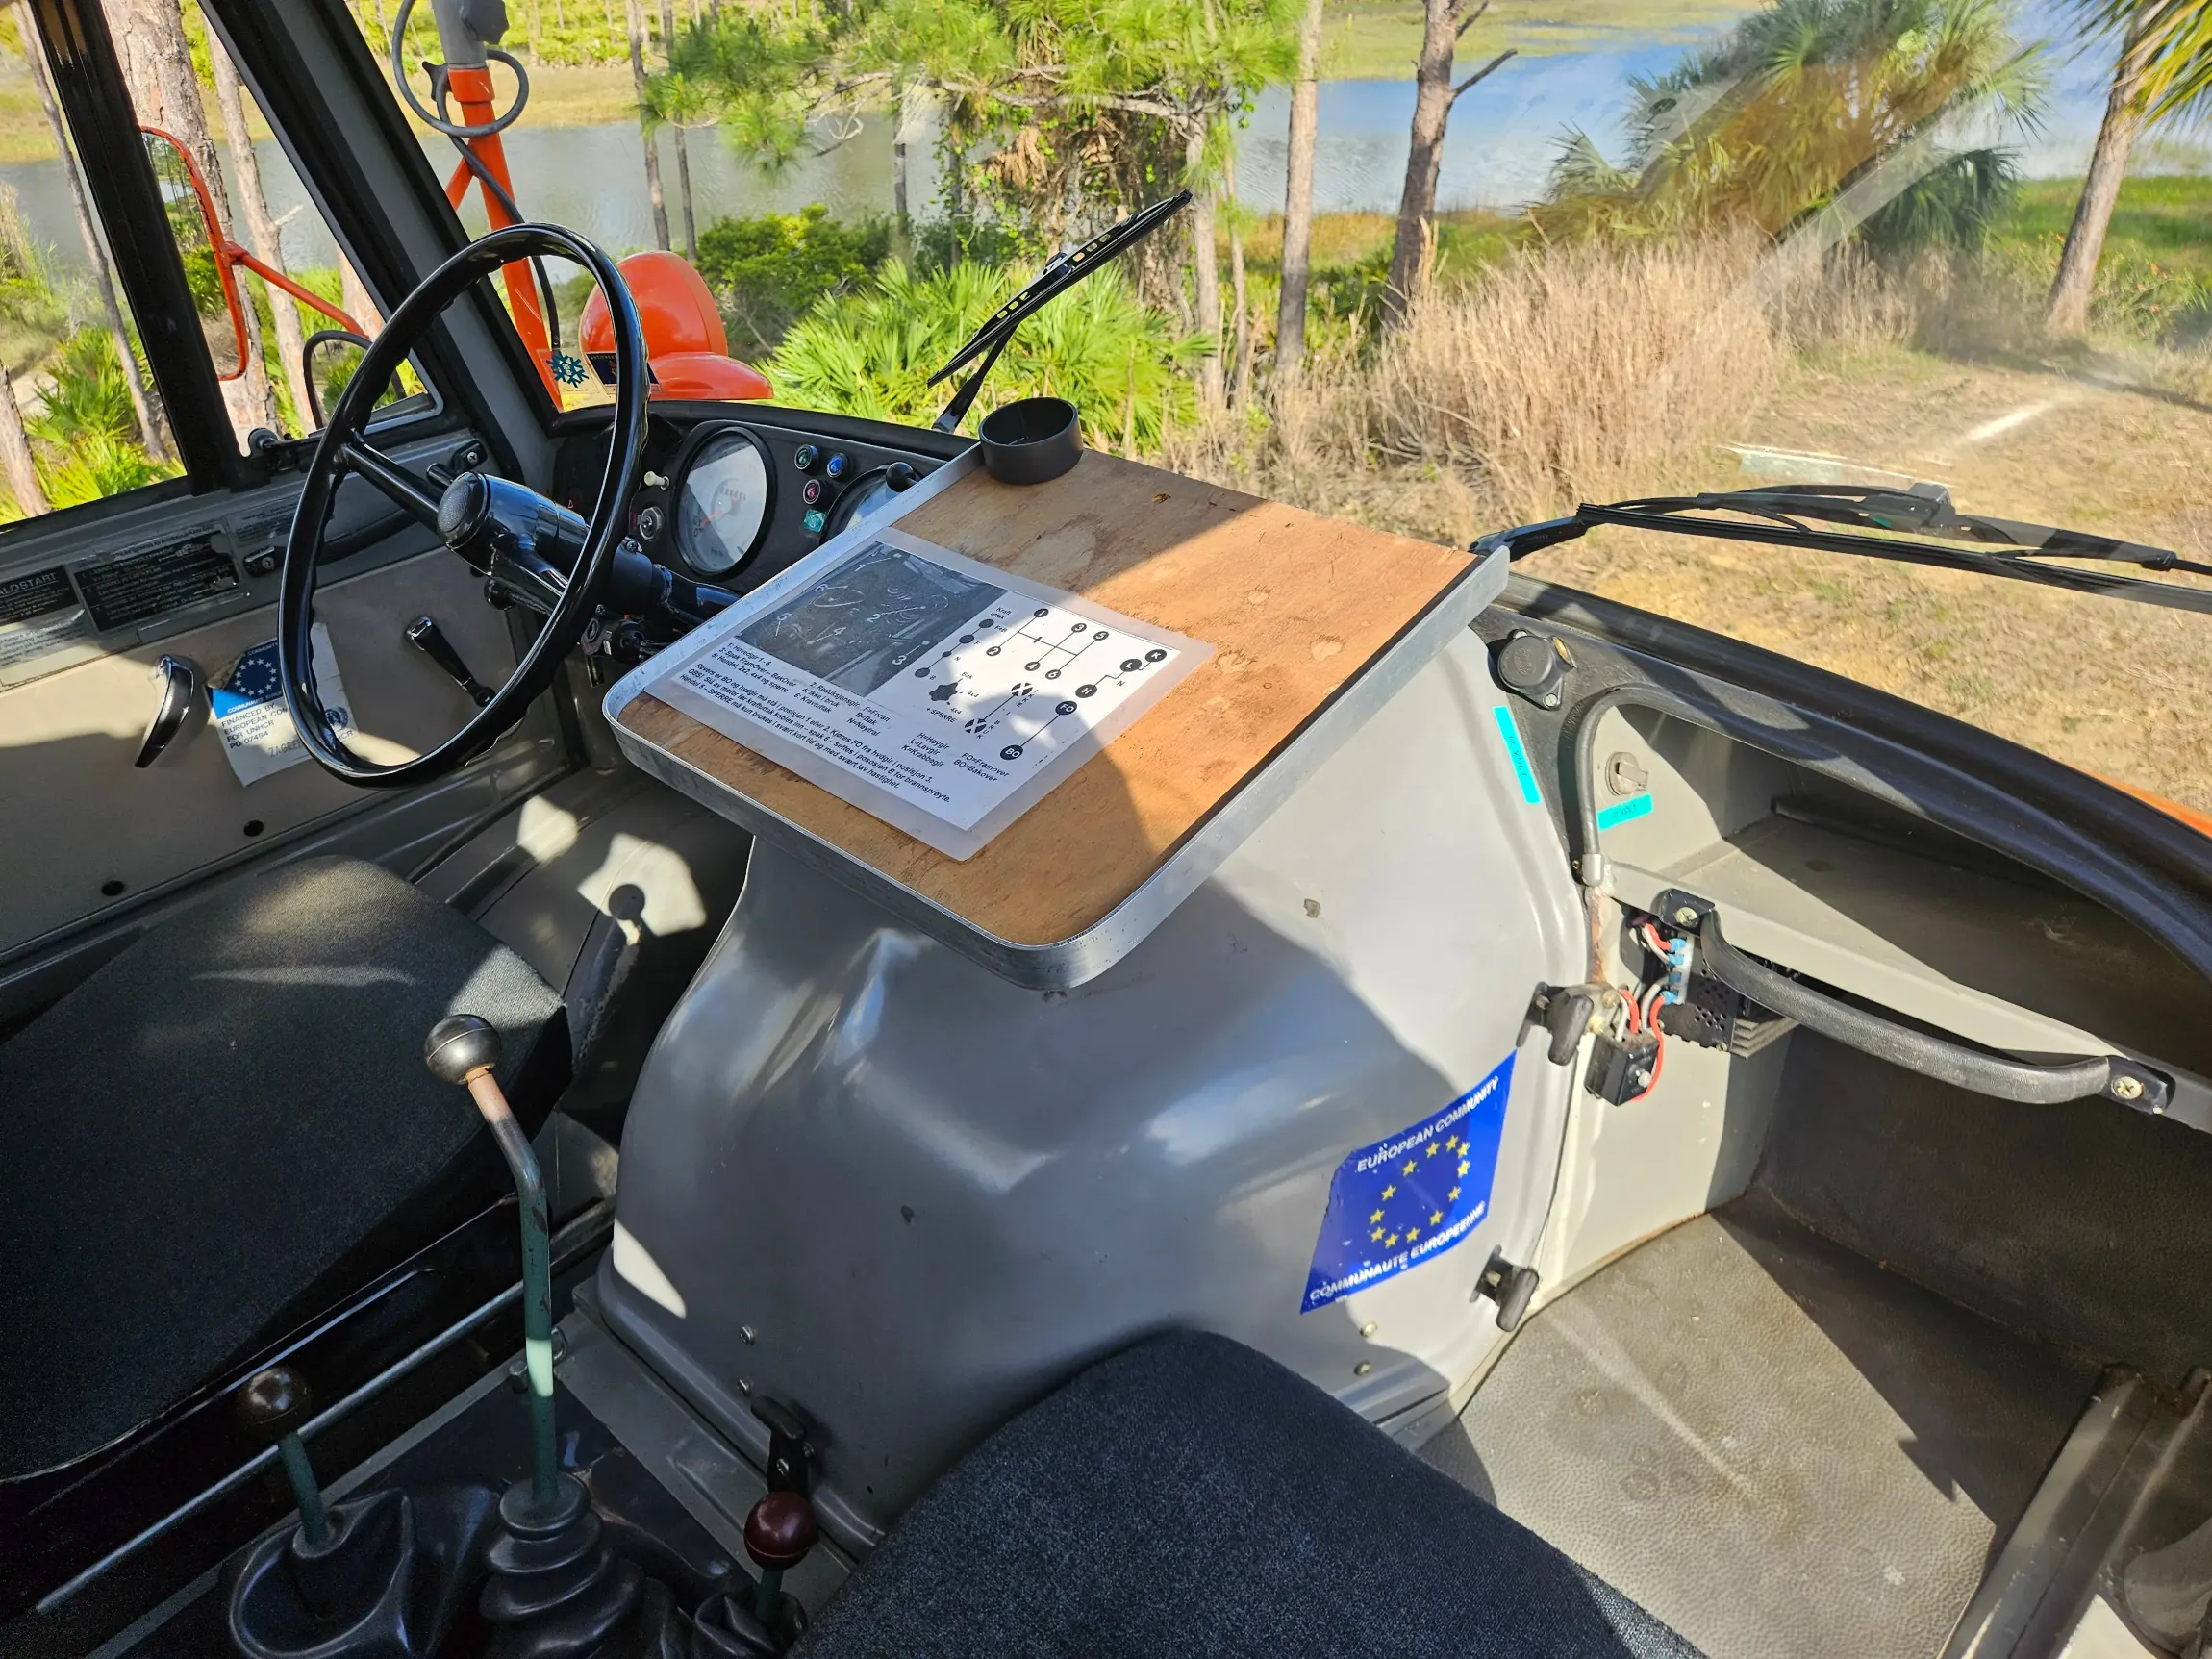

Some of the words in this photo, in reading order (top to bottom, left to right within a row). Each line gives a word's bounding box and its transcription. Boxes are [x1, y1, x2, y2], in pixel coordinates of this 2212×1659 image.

[854, 564, 866, 572] 1
[814, 583, 829, 592] 6
[776, 612, 792, 621] 5
[866, 613, 882, 623] 2
[724, 650, 741, 662] Spak
[771, 673, 797, 688] BakOver
[892, 655, 908, 666] 3
[750, 672, 762, 681] 4x4
[768, 681, 789, 693] sperre
[817, 684, 861, 708] Reduksjonsgir
[824, 697, 841, 709] bruk
[221, 708, 262, 728] FINANCED
[264, 703, 276, 713] BY
[863, 706, 891, 722] F=Foran
[930, 709, 958, 724] SPERRE
[1060, 703, 1074, 713] FO
[224, 715, 268, 736] EUROPEAN
[679, 674, 700, 689] Hendel
[707, 688, 733, 704] SPERRE
[731, 700, 742, 709] må
[740, 705, 753, 715] kun
[751, 711, 772, 724] brukes
[775, 723, 793, 735] svært
[792, 731, 807, 741] kort
[805, 738, 816, 746] tid
[822, 746, 840, 757] med
[838, 754, 858, 767] svært
[856, 763, 868, 772] lav
[688, 668, 703, 680] OBS!
[703, 676, 713, 685] Slå
[720, 685, 738, 697] motor
[746, 697, 773, 716] kraftuttak
[773, 712, 793, 726] kobles
[793, 720, 805, 730] inn
[808, 728, 824, 740] spak
[833, 742, 854, 755] settes
[893, 770, 906, 780] for
[695, 663, 716, 676] Revers
[721, 675, 733, 684] BO
[731, 681, 740, 690] og
[757, 693, 767, 702] må
[767, 698, 778, 707] stå
[780, 704, 806, 720] posisjon
[809, 719, 825, 730] eller
[830, 728, 852, 742] Kjøres
[850, 739, 863, 748] FO
[861, 745, 872, 754] fra
[896, 763, 926, 780] posisjon
[846, 717, 881, 737] N=Nøytral
[854, 712, 877, 726] B=Bak
[227, 732, 243, 743] FOR
[246, 719, 275, 736] UNHCR
[243, 731, 269, 744] 07494
[917, 732, 950, 750] H=Høygir
[901, 744, 944, 768] K=Krabbegir
[910, 738, 941, 756] L=Lavgir
[1004, 748, 1020, 758] BO
[953, 759, 998, 783] BO=Bakover
[962, 752, 1010, 778] FO=Framover
[1357, 1124, 1434, 1173] EUROPEAN
[1434, 1075, 1499, 1133] COMMUNITY
[1309, 1252, 1409, 1302] COMMUNAUTE
[1410, 1201, 1486, 1259] EUROPEENNE
